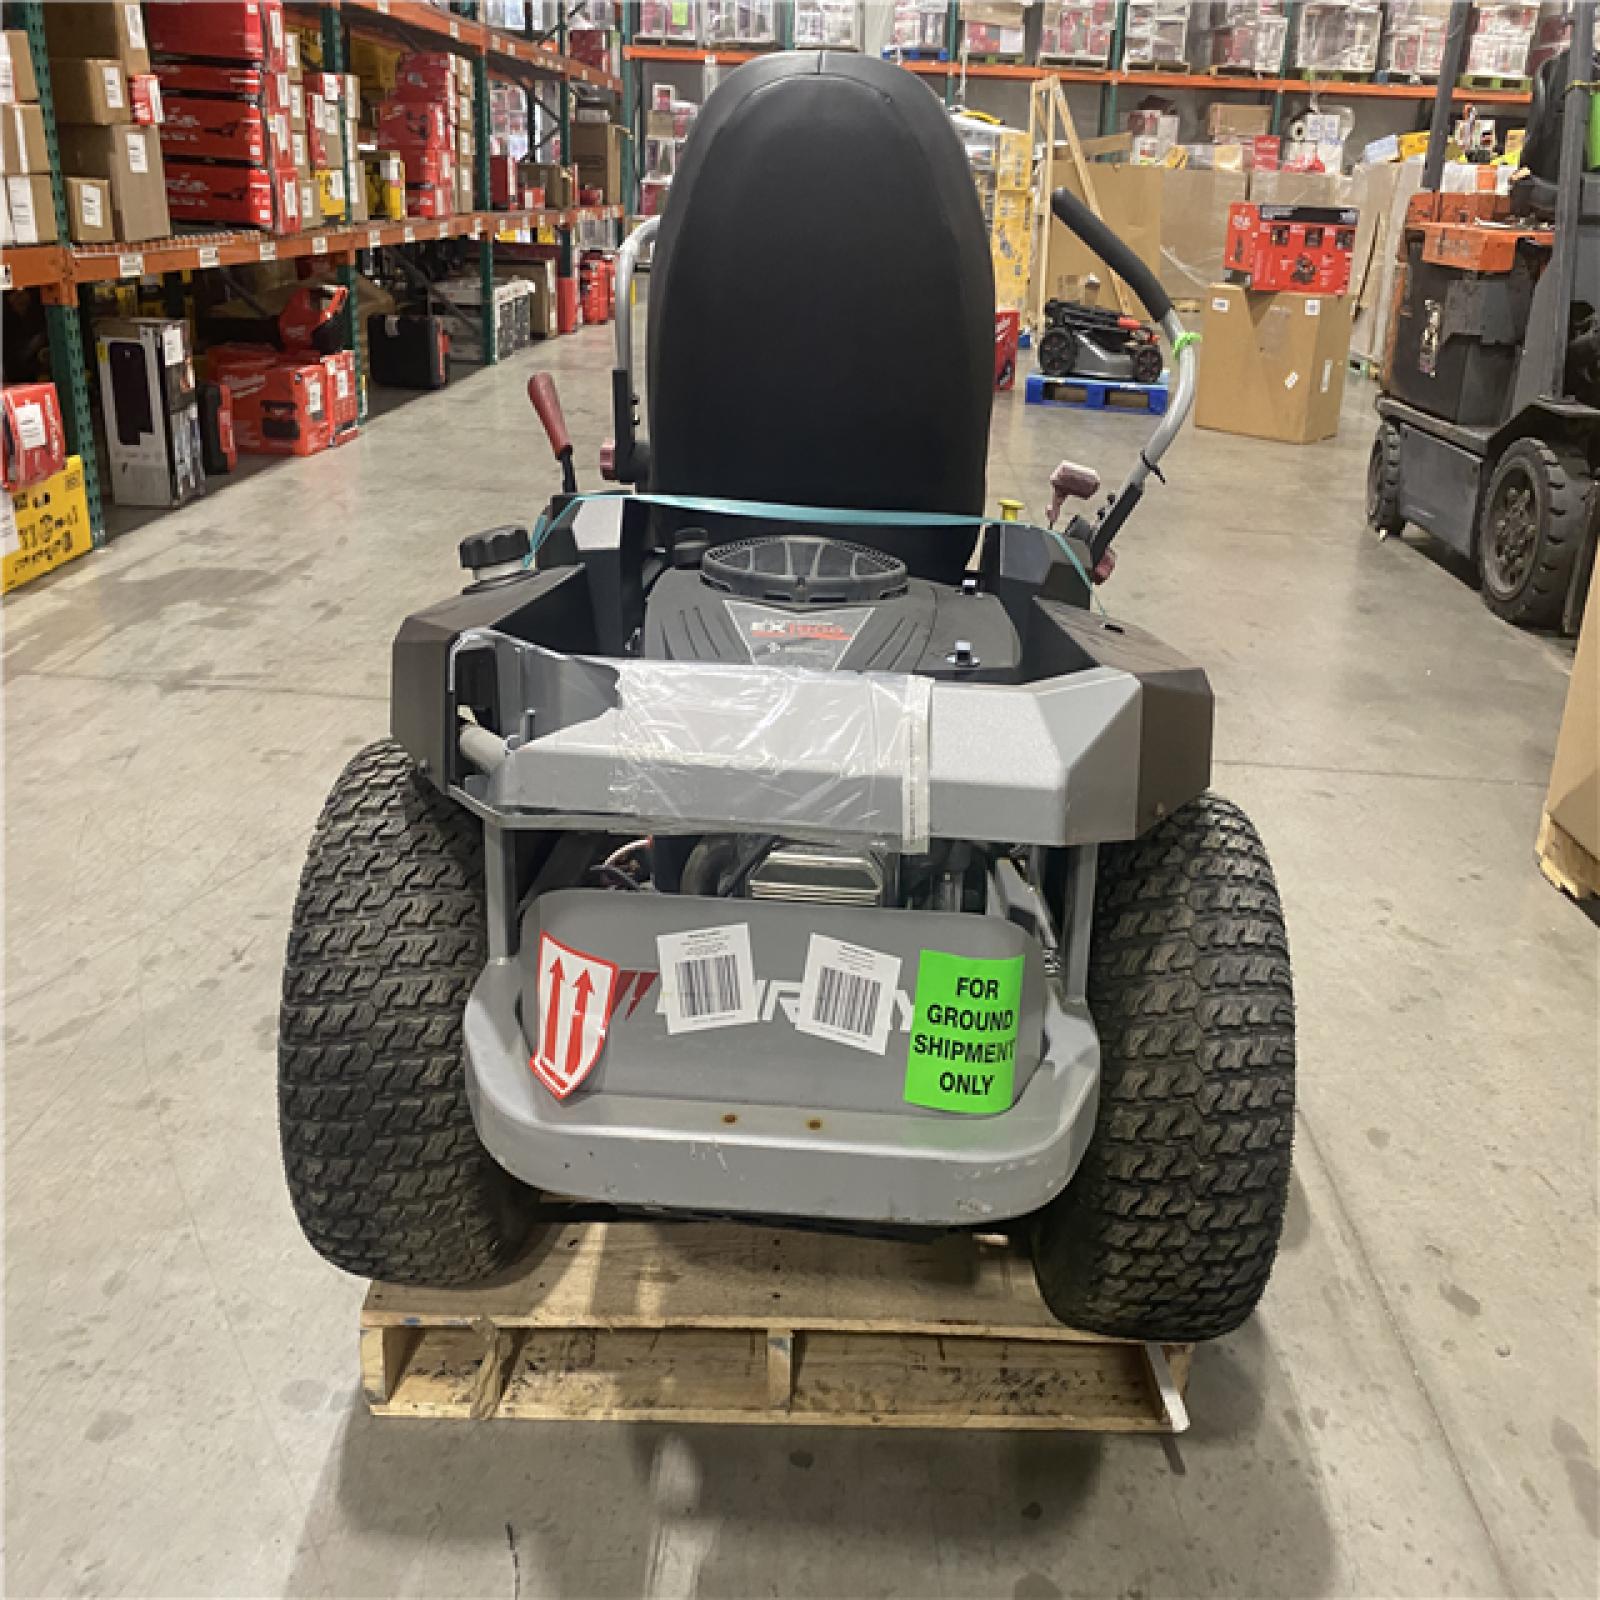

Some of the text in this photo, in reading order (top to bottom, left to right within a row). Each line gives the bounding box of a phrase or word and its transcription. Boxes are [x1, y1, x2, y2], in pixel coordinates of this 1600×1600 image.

[956, 977, 999, 1000] FOR
[927, 1004, 1014, 1031] GROUND
[914, 1034, 1016, 1064] SHIPMENT
[939, 1072, 994, 1096] ONLY
